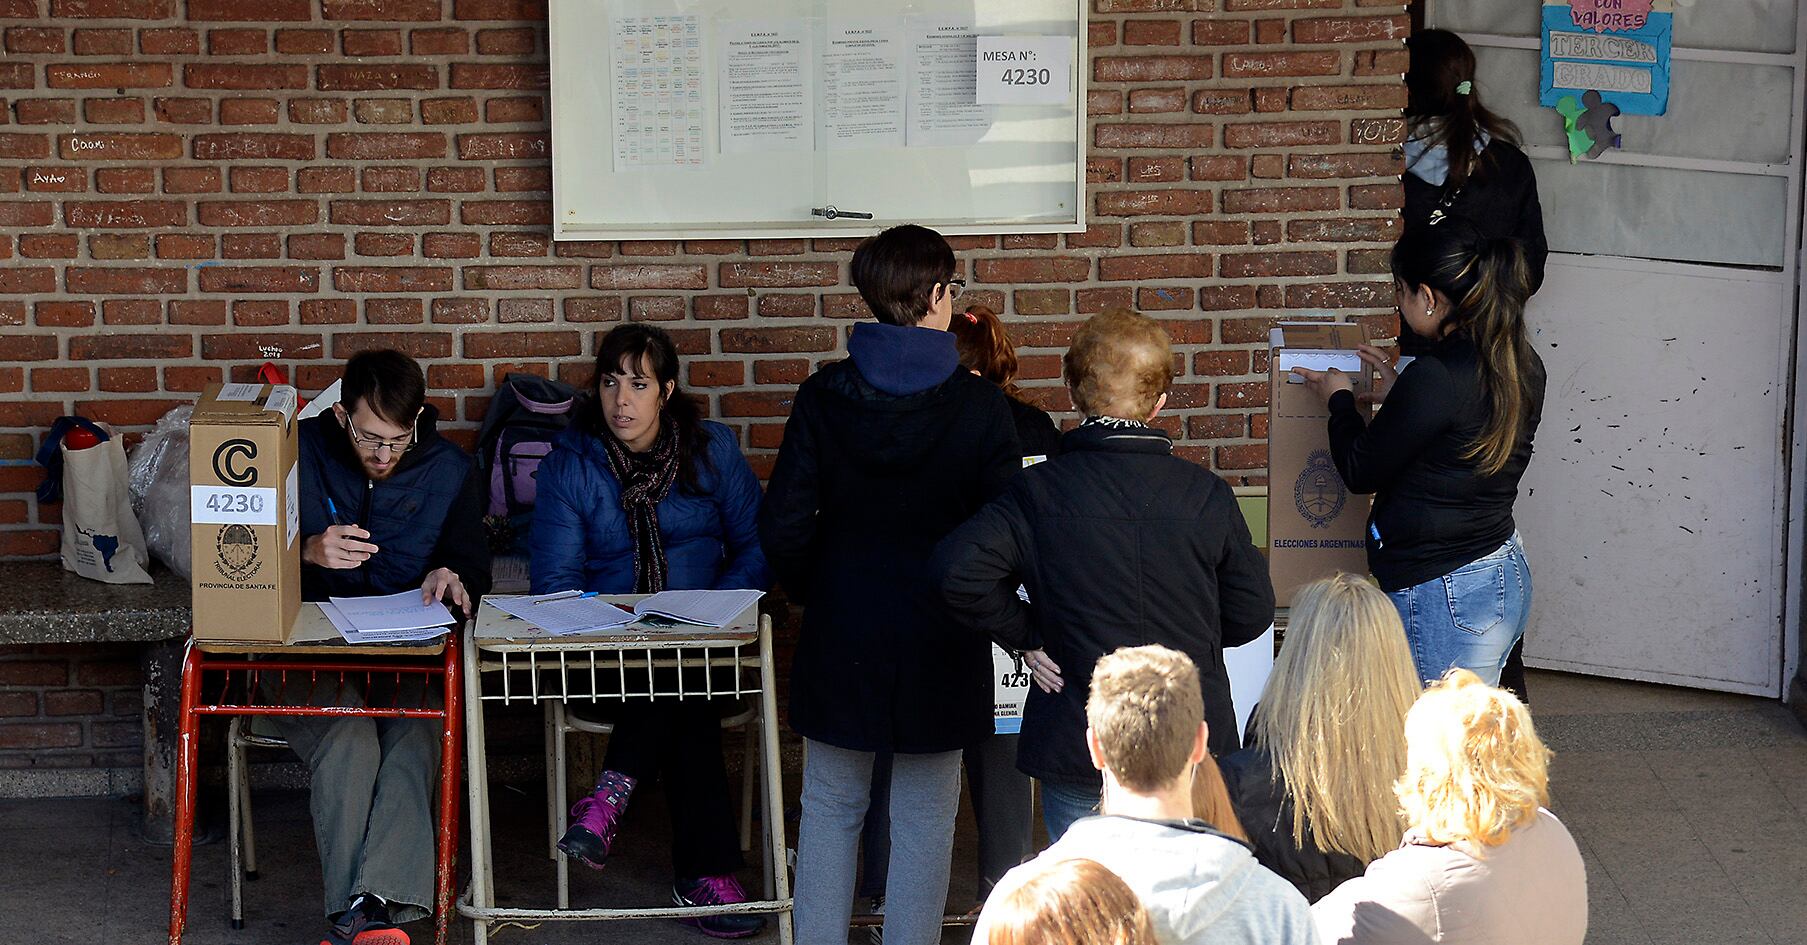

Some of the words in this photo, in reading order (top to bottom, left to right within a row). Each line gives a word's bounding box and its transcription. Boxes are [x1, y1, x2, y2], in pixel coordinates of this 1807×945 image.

[1573, 11, 1645, 27] VALORES
[983, 51, 1016, 61] MESA
[1551, 34, 1655, 60] TERCER
[1001, 68, 1051, 85] 4230
[1556, 63, 1650, 90] GRADO
[212, 438, 258, 487] C
[206, 494, 264, 513] 4230
[1274, 539, 1318, 548] ELECCIONES
[1319, 540, 1365, 549] ARGENTINAS
[213, 560, 235, 582] TRIBUNAL
[236, 560, 263, 582] ELECTORAL
